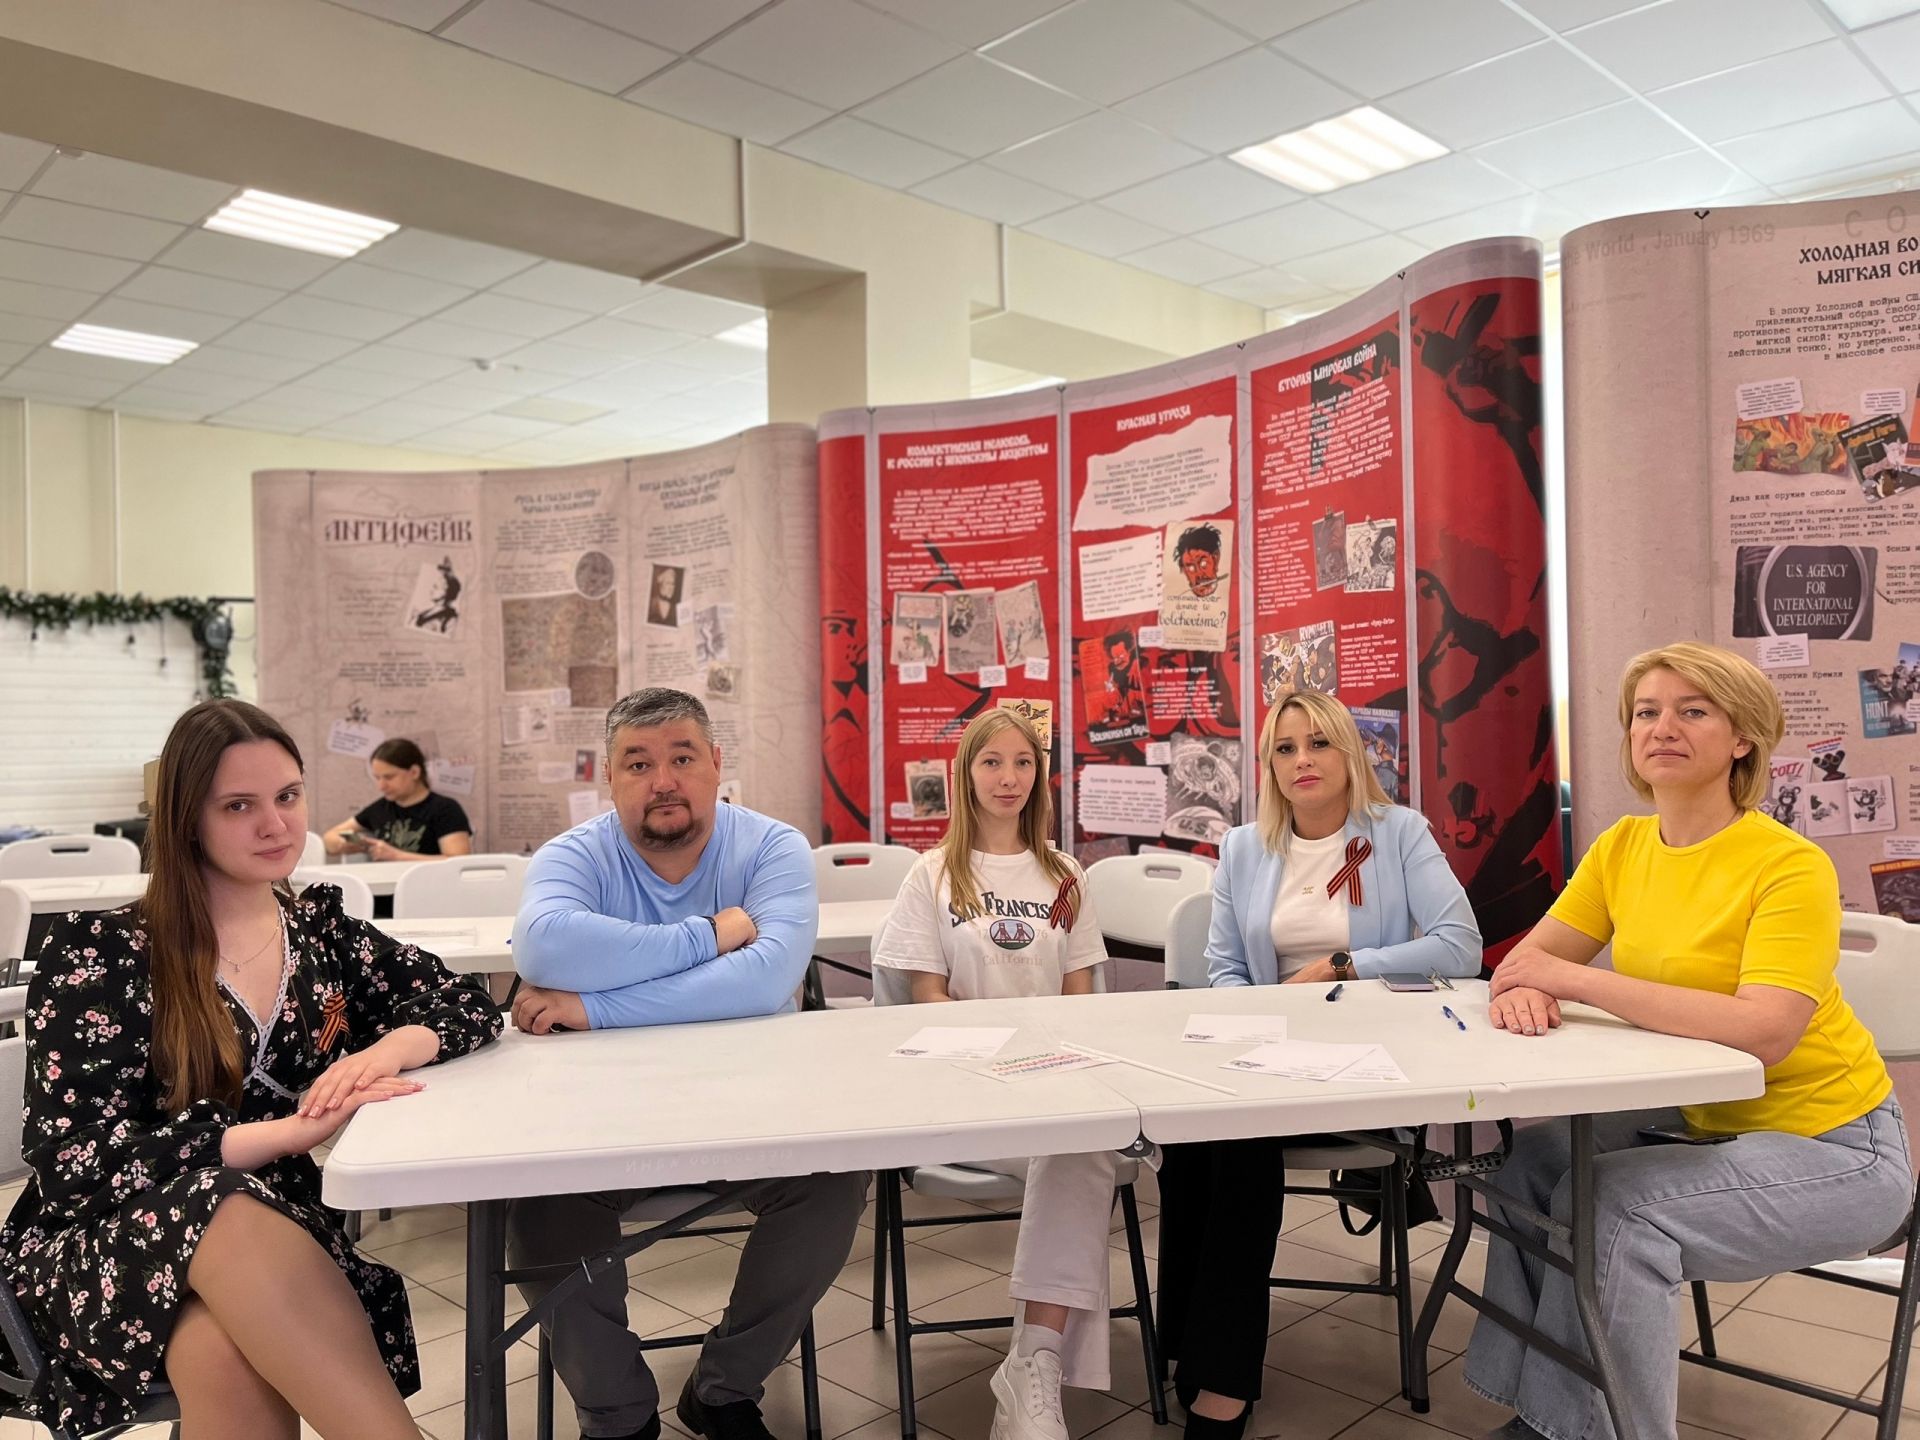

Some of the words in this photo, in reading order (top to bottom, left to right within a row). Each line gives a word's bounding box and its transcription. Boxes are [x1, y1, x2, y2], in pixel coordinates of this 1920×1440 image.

[1655, 229, 1721, 250] January
[1727, 223, 1776, 245] 1969
[1798, 240, 1889, 264] ХОЛОДНАЯ
[1817, 264, 1891, 285] МЯГКАЯ
[1769, 307, 1776, 316] В
[1781, 306, 1810, 315] эпоху
[1816, 300, 1864, 312] Холодной
[1869, 296, 1900, 307] войны
[1905, 293, 1920, 302] СШ
[1756, 312, 1843, 328] привлекательный
[1849, 309, 1879, 319] образ
[1733, 327, 1791, 339] противовес
[1796, 319, 1886, 333] «тоталитарному»
[1756, 336, 1791, 346] мягкой
[1797, 333, 1831, 343] силой:
[1728, 347, 1791, 358] действовали
[1838, 342, 1851, 350] но
[1836, 347, 1885, 359] массовое
[1116, 412, 1156, 432] КРАСНАЯ
[1774, 492, 1805, 500] оружие
[1810, 489, 1846, 497] свободы
[325, 515, 472, 542] АНТИФЕЙК
[1806, 563, 1849, 578] AGENCY
[1806, 581, 1826, 595] FOR
[1773, 597, 1854, 611] INTERNATIONAL
[1776, 613, 1850, 627] DEVELOPMENT
[1777, 672, 1808, 681] против
[1812, 671, 1843, 680] Кремля
[1865, 700, 1889, 719] HUNT
[1769, 762, 1804, 780] COTT!
[948, 901, 982, 928] SN
